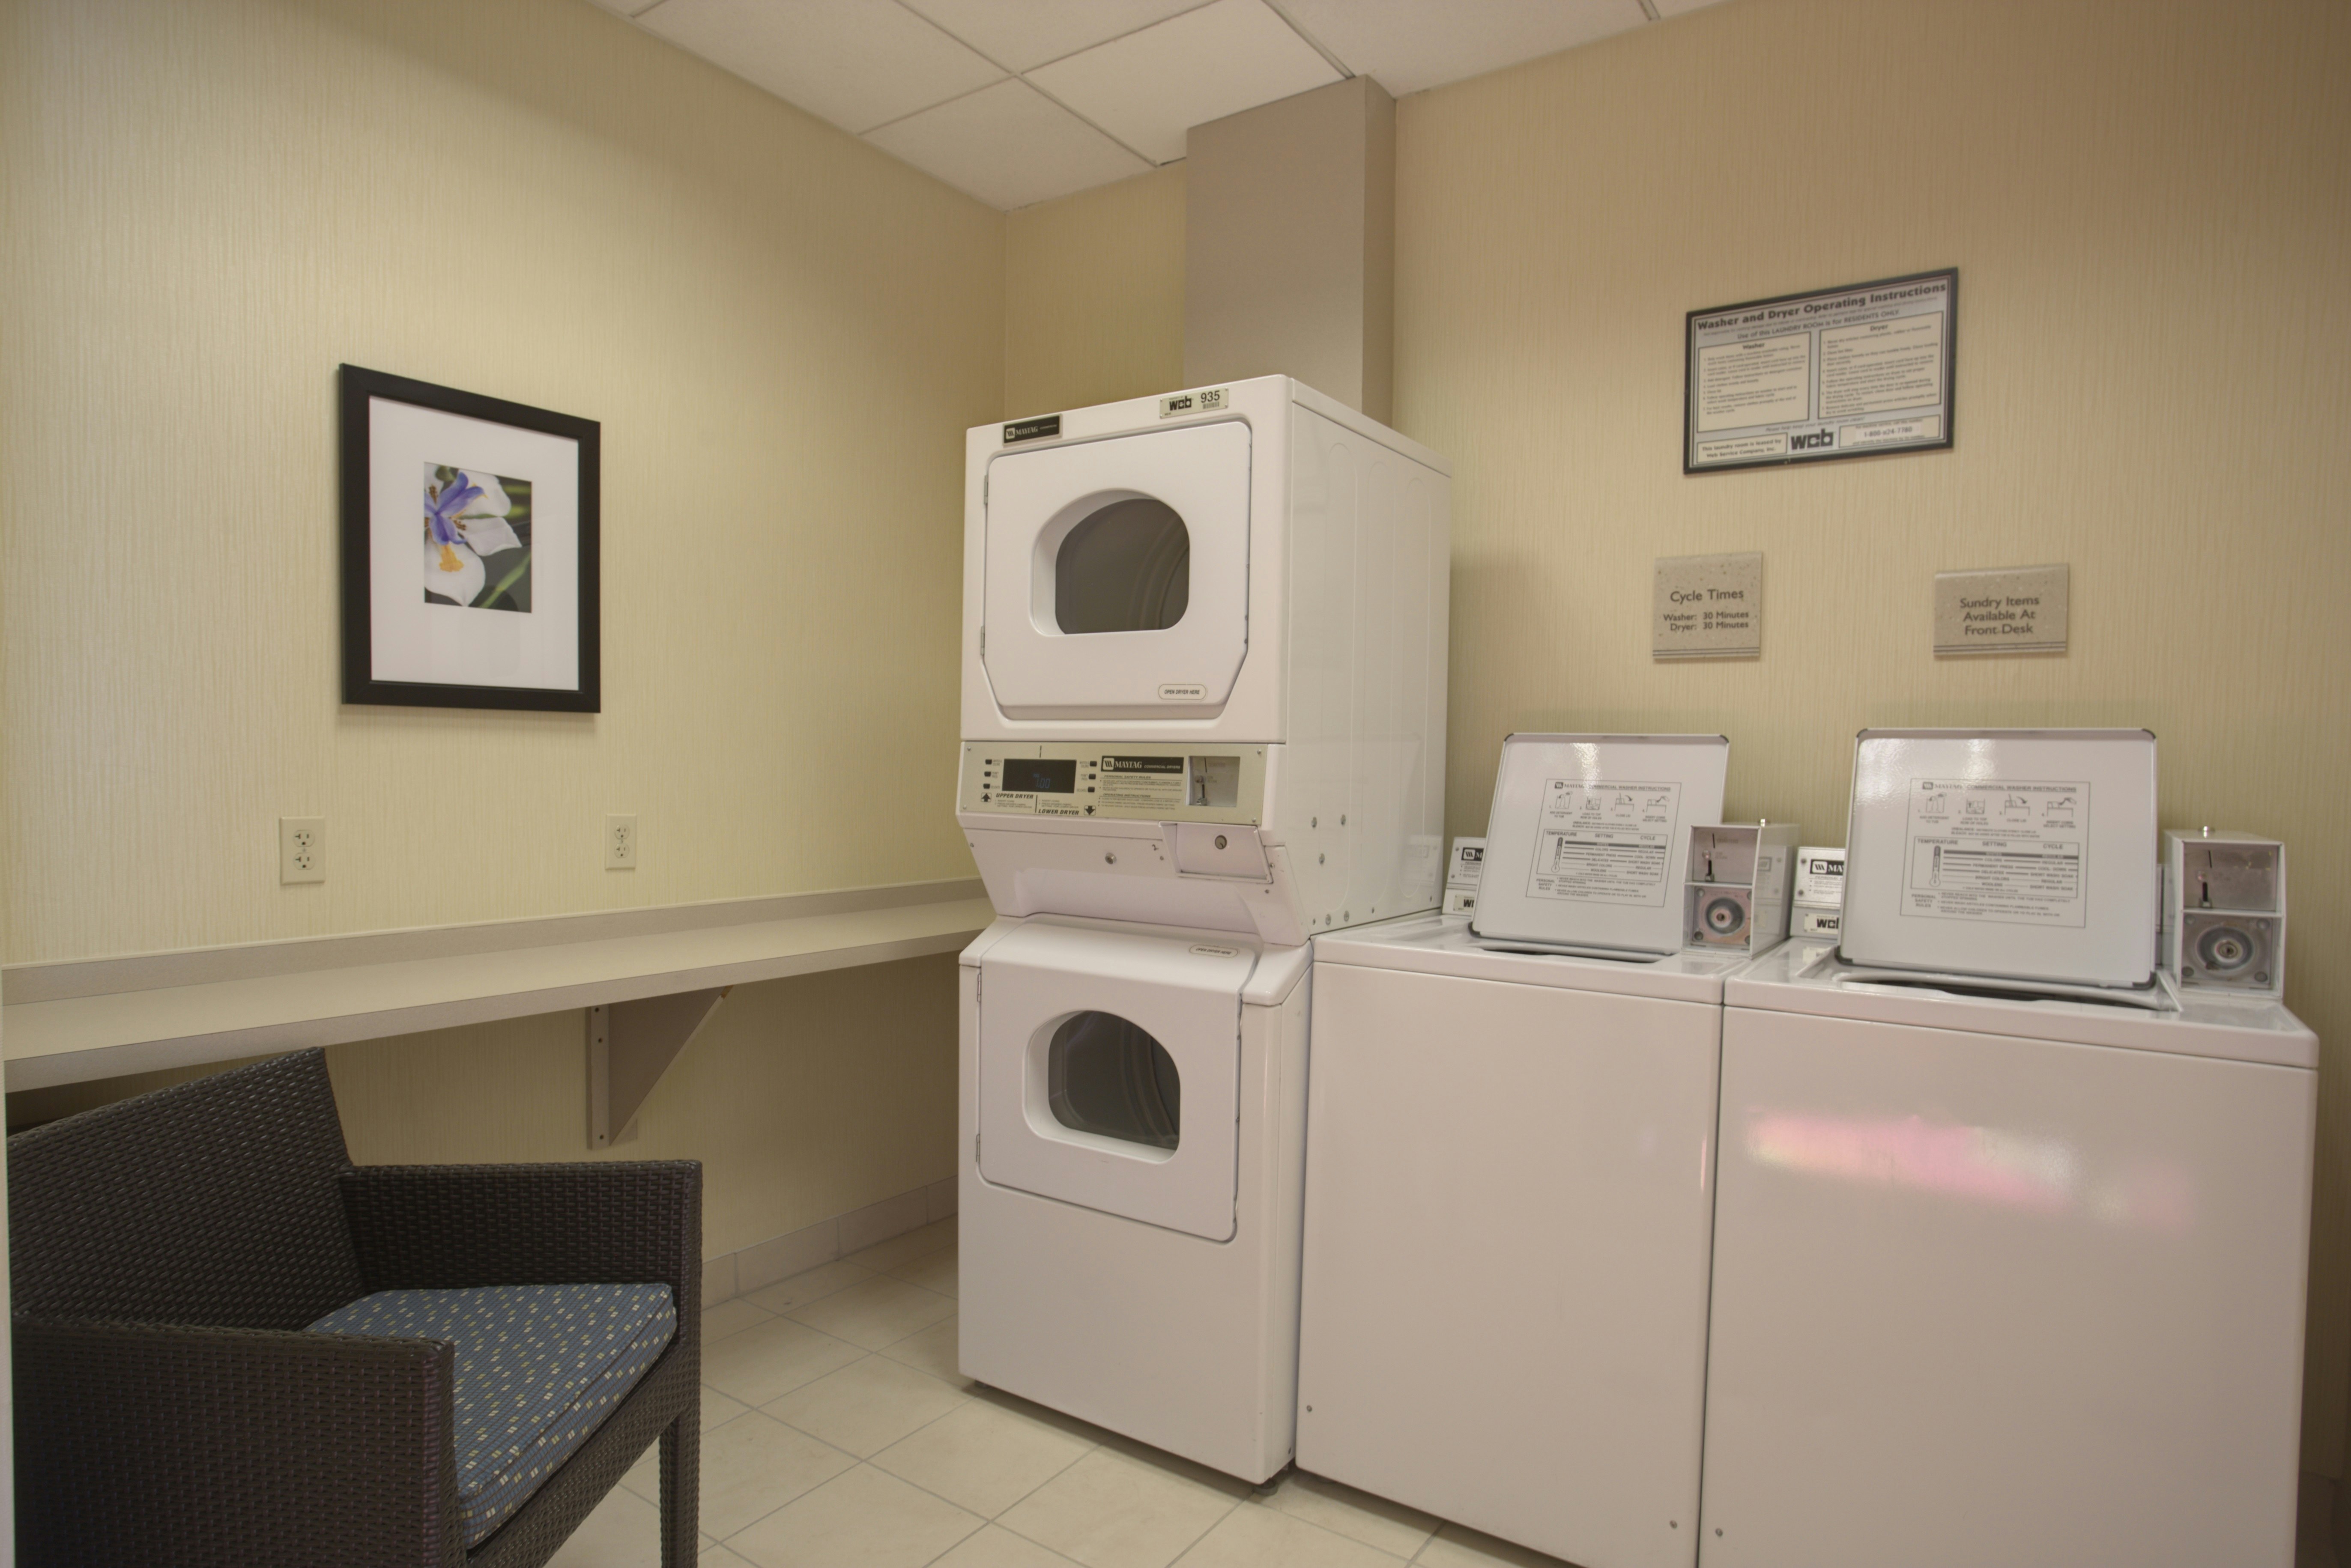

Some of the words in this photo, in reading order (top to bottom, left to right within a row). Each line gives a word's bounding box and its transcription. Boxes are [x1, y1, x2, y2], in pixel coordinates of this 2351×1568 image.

[1698, 317, 1739, 330] Washer
[1742, 312, 1764, 323] and
[1768, 307, 1800, 319] Dryer
[1804, 296, 1866, 313] Operating
[1870, 283, 1946, 303] Instructions
[1772, 325, 1801, 334] LAUNDRY
[1844, 314, 1879, 323] RESIDENTS
[1881, 310, 1899, 318] ONLY
[1201, 390, 1220, 403] 935
[1016, 426, 1038, 435] MAYTAG
[1670, 590, 1703, 605] Cycle
[1707, 589, 1744, 600] Times
[1960, 597, 2001, 609] Sundry
[2006, 596, 2039, 606] Items
[1664, 613, 1697, 621] Washer:
[1716, 611, 1748, 619] Minutes
[1963, 610, 2016, 622] Available
[2020, 609, 2036, 620] At
[1670, 623, 1697, 632] Dryer:
[1965, 625, 1997, 635] Front
[2002, 623, 2033, 634] Desk
[1036, 778, 1051, 788] 1.00
